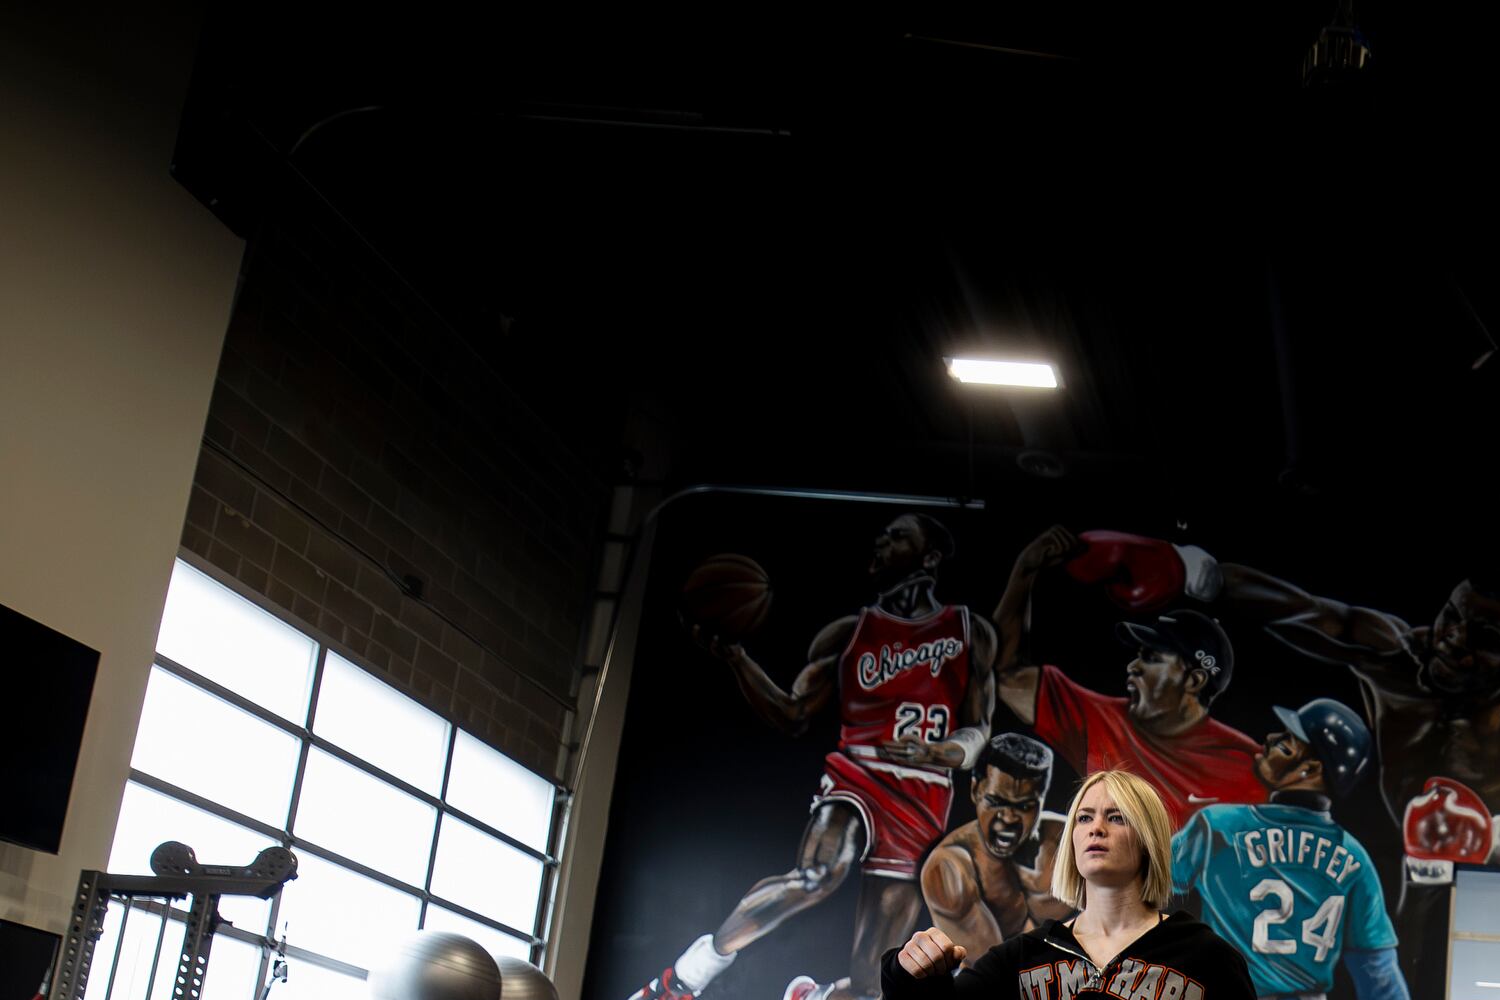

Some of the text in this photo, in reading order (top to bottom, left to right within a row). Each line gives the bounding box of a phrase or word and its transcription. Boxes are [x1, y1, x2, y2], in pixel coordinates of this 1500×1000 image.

[857, 637, 963, 692] Chicago
[893, 702, 950, 744] 23
[1243, 827, 1362, 885] GRIFFEY
[1249, 878, 1345, 963] 24
